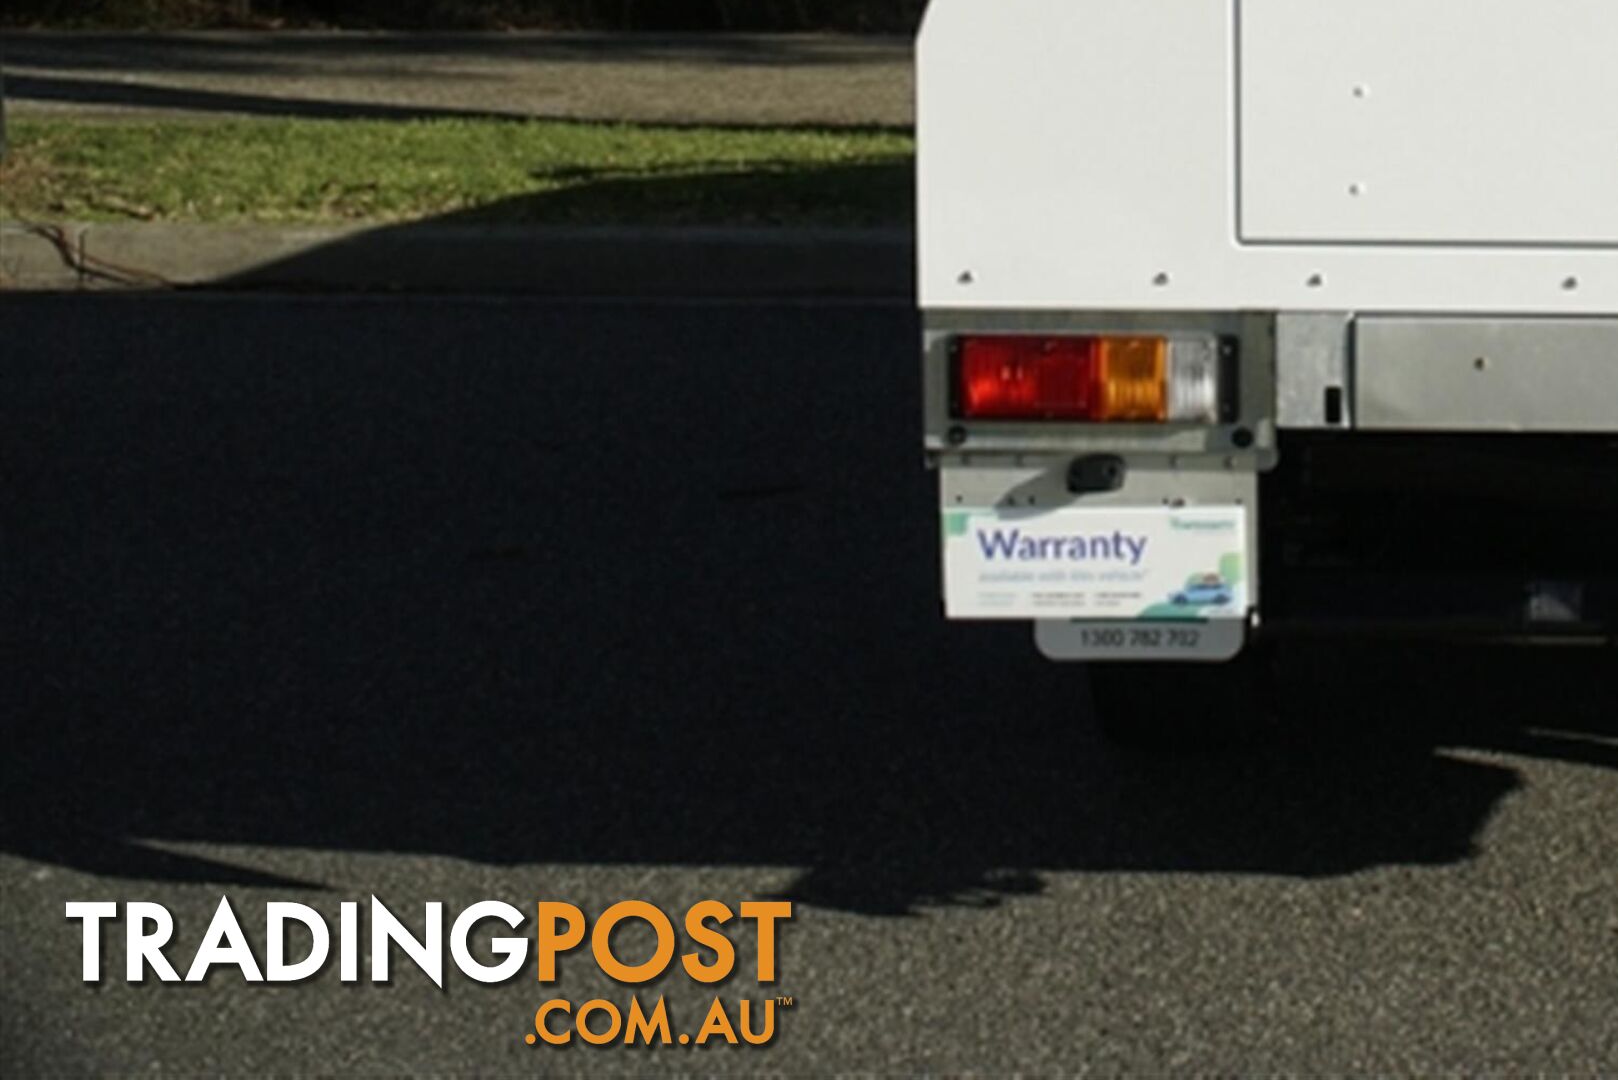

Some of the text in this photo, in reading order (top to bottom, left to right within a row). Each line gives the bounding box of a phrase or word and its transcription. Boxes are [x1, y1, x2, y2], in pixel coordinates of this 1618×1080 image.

[977, 529, 1148, 566] Warranty
[1080, 627, 1124, 648] 1300
[1129, 627, 1161, 648] 782
